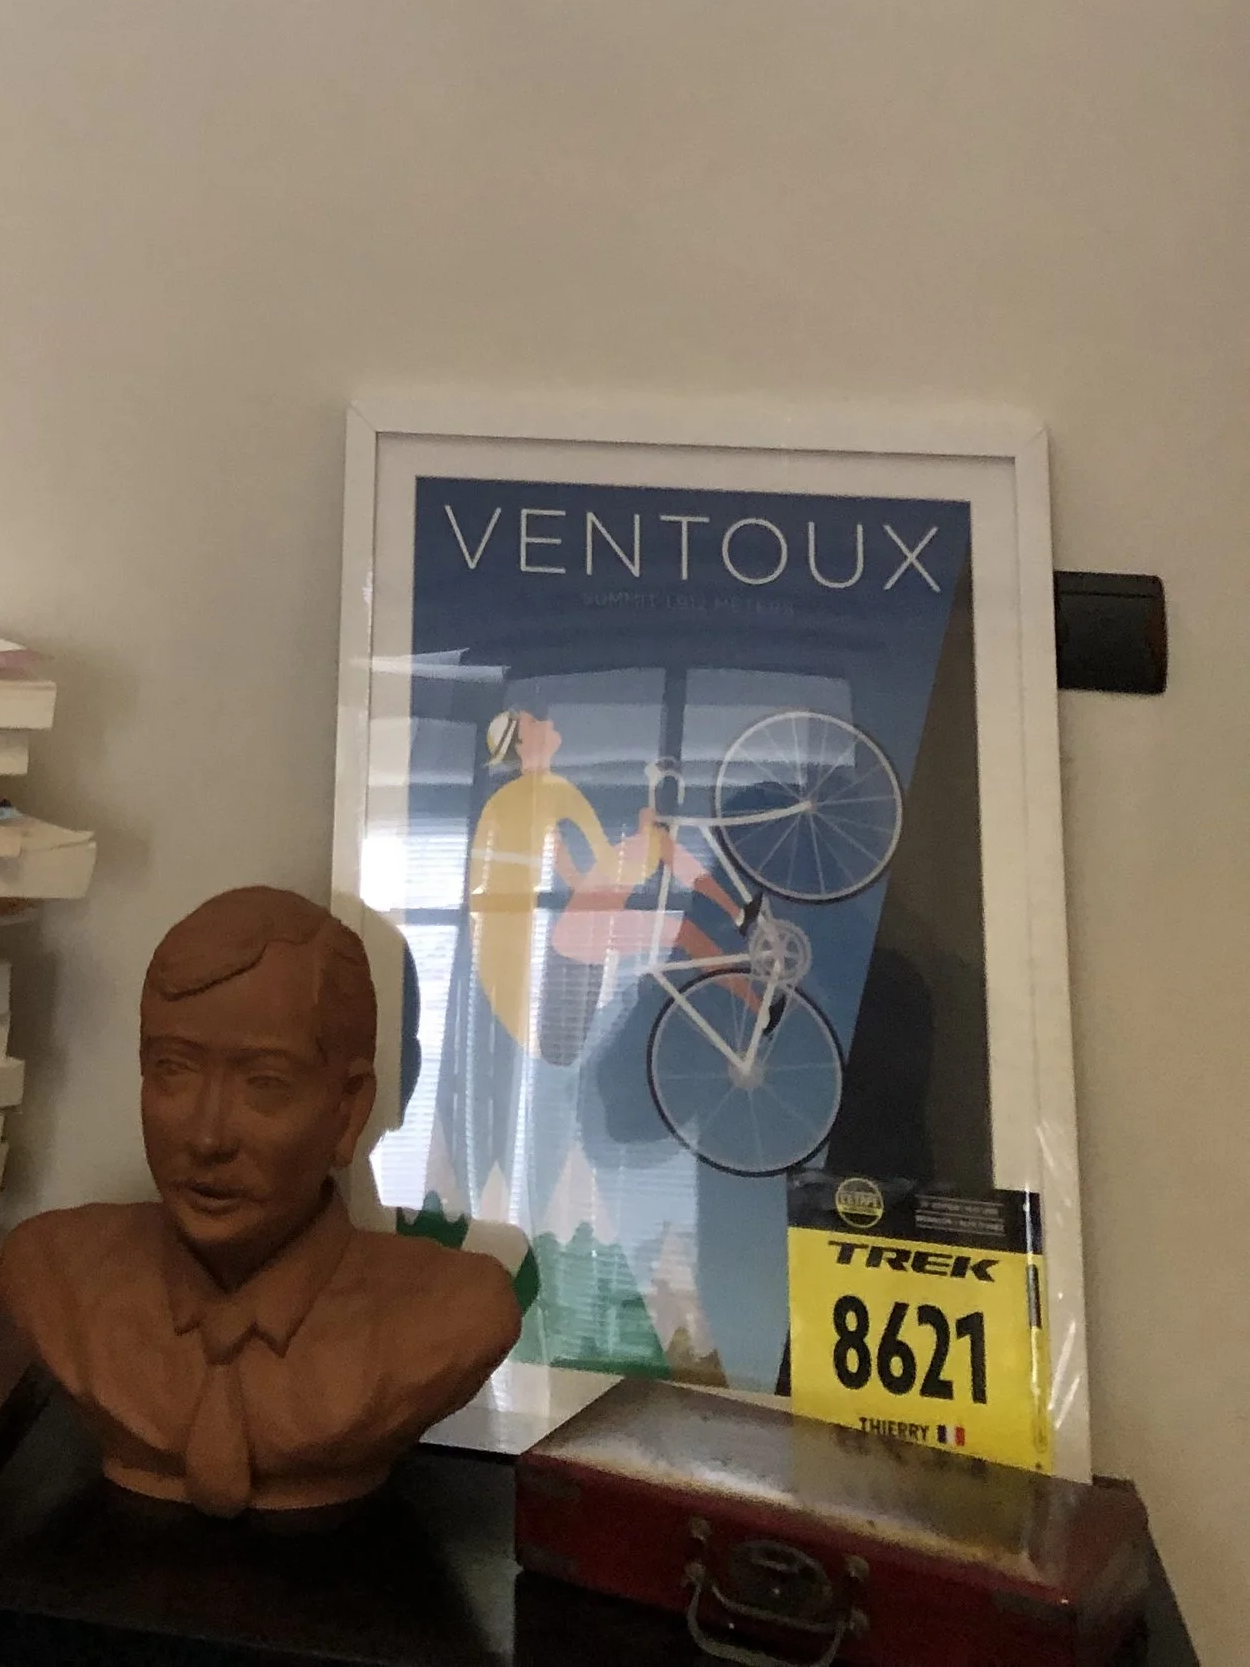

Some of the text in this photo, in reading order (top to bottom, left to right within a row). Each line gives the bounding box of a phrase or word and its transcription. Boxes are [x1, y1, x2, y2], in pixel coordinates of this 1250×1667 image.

[444, 504, 942, 594] VENTOUX
[827, 1239, 1001, 1283] TREK
[832, 1294, 988, 1406] 8621
[858, 1416, 931, 1443] THIERRY
